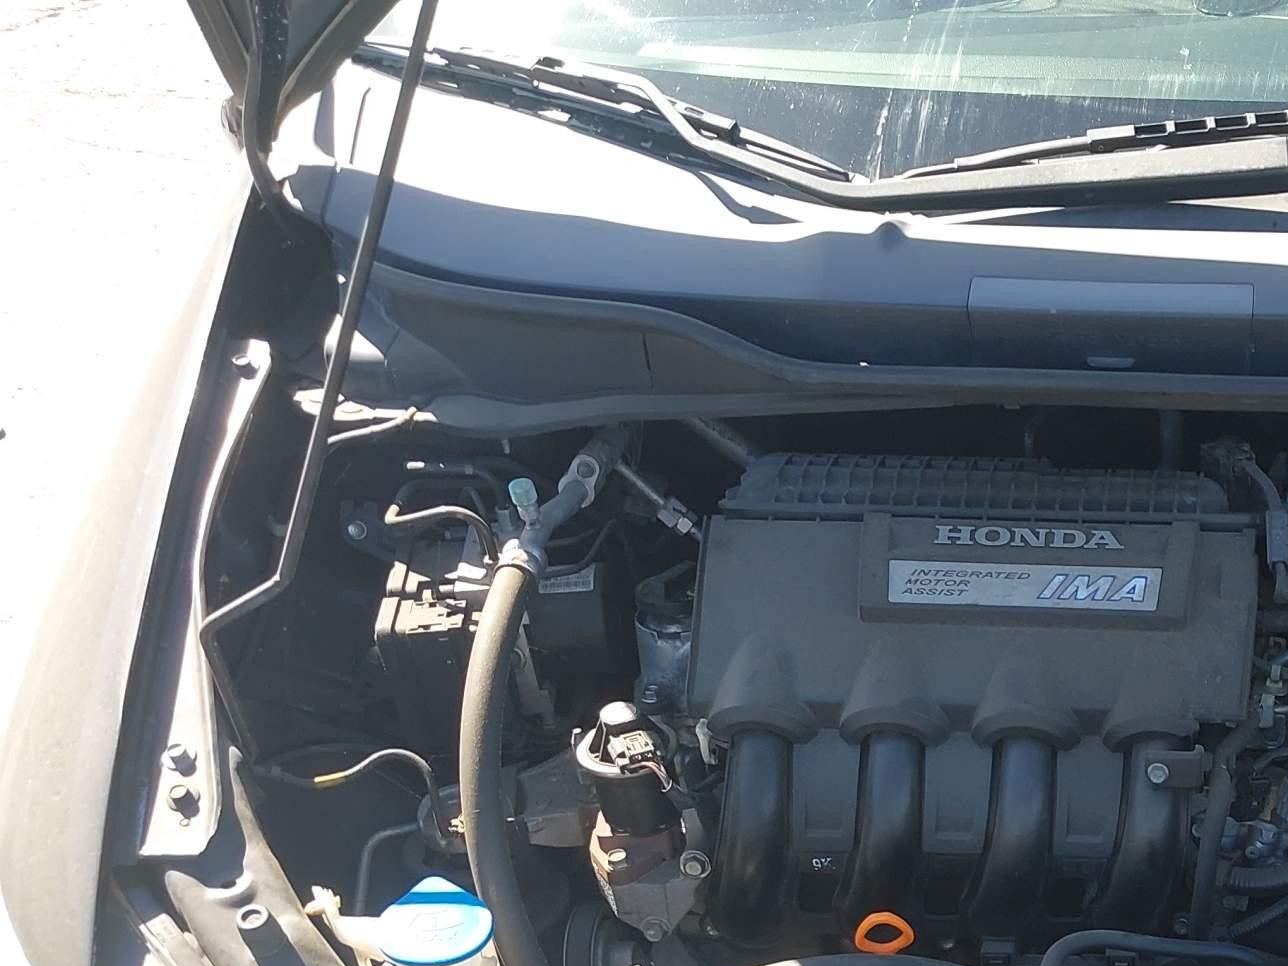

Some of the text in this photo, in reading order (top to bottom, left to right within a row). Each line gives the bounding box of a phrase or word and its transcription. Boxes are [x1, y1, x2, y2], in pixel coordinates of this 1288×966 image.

[933, 525, 1125, 550] HONDA
[910, 568, 1032, 581] INTEGRATED
[904, 578, 971, 588] MOTOR
[1037, 573, 1150, 602] IMA
[901, 587, 969, 598] ASSIST
